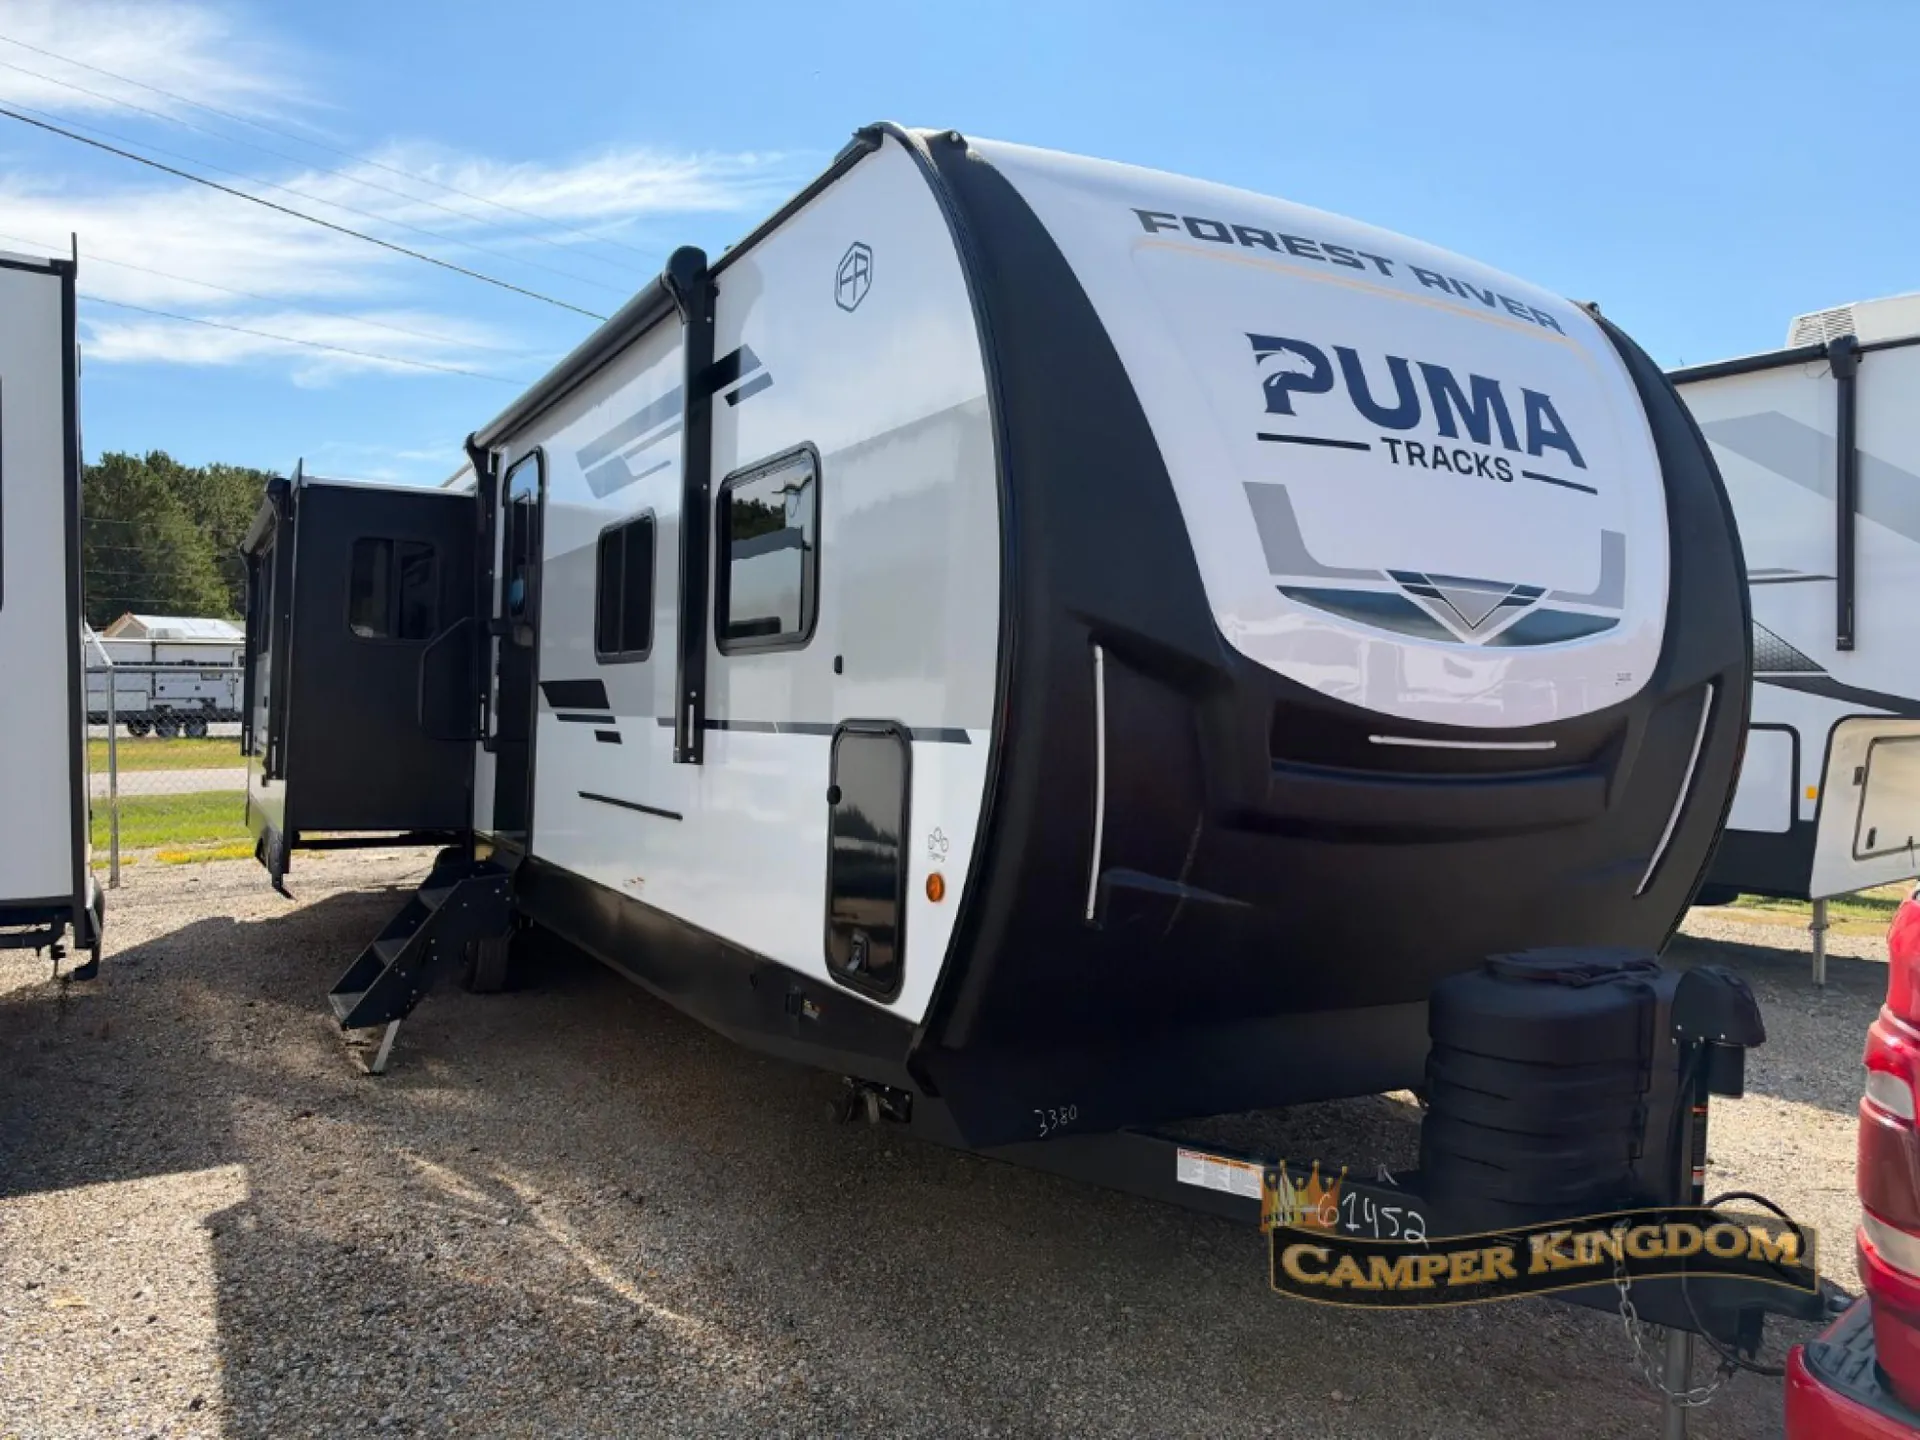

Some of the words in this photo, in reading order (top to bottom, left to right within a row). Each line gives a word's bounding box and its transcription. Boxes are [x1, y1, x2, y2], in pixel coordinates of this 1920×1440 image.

[1130, 208, 1394, 277] FOREST
[1407, 264, 1566, 336] RIVER
[1244, 332, 1588, 469] PUMA
[1380, 436, 1514, 483] TRACKS
